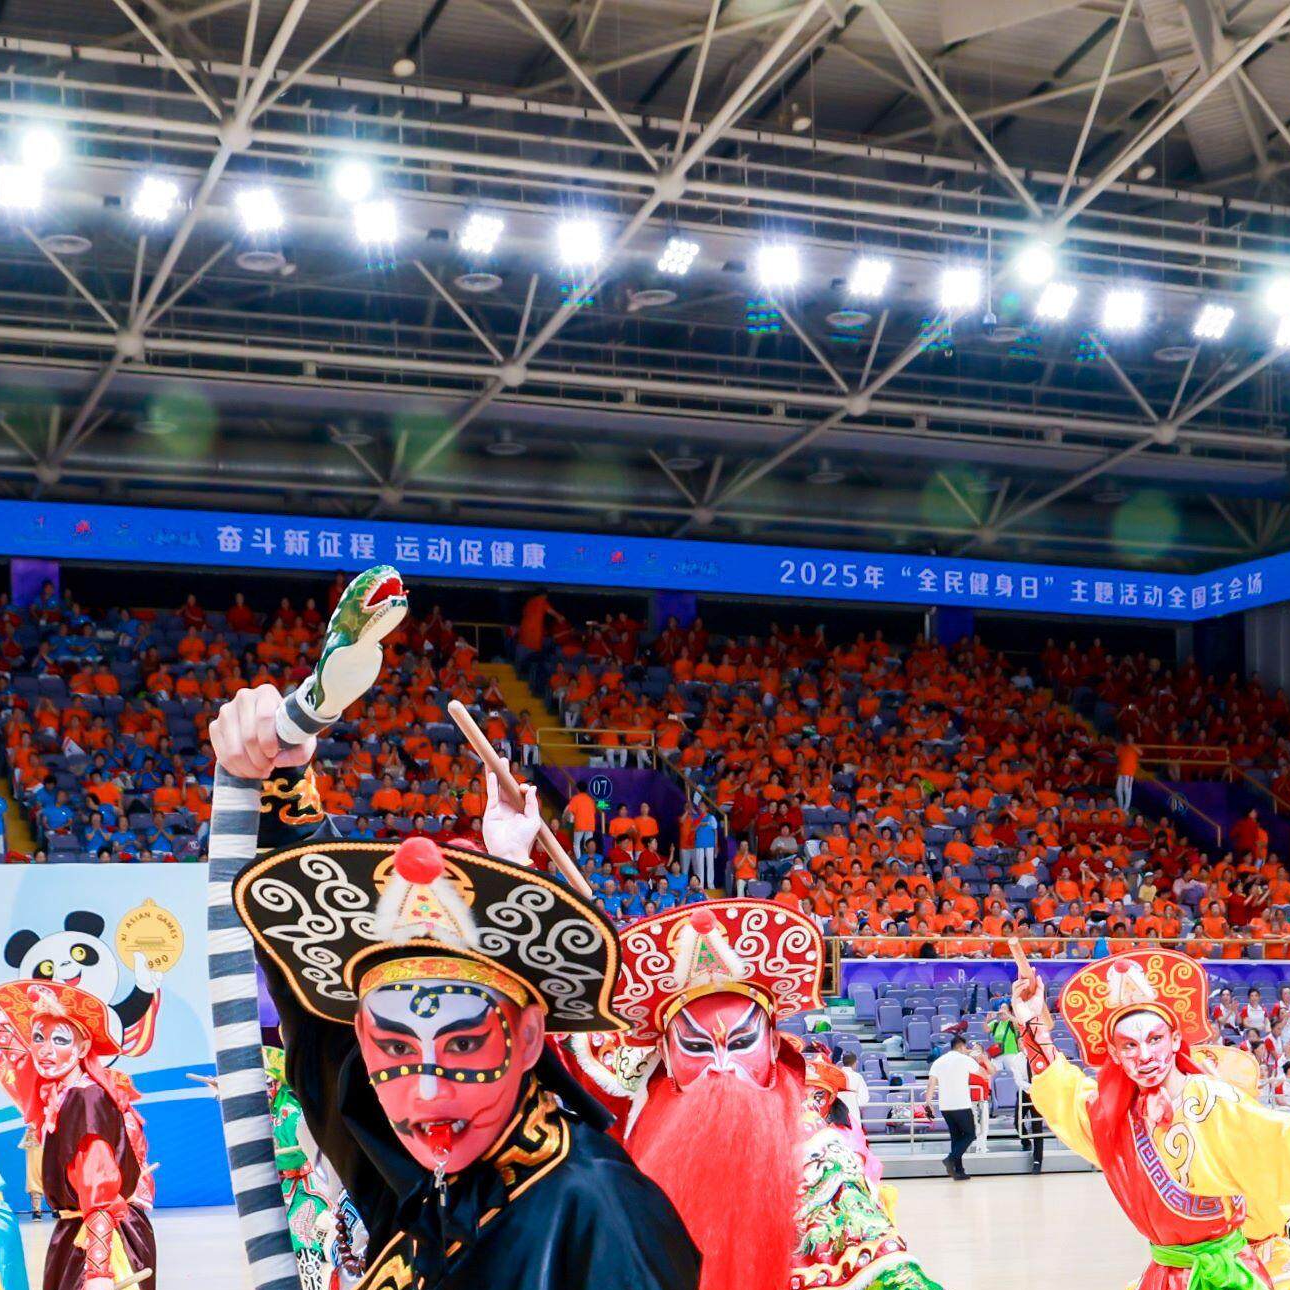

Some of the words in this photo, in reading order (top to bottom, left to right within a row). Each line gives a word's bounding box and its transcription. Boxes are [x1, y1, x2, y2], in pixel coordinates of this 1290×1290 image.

[217, 525, 375, 560] 奋斗新征程
[394, 536, 547, 570] 运动促健康
[592, 780, 608, 795] 07
[125, 911, 151, 929] ASIAN
[156, 914, 179, 940] GAMES
[147, 954, 169, 969] 990
